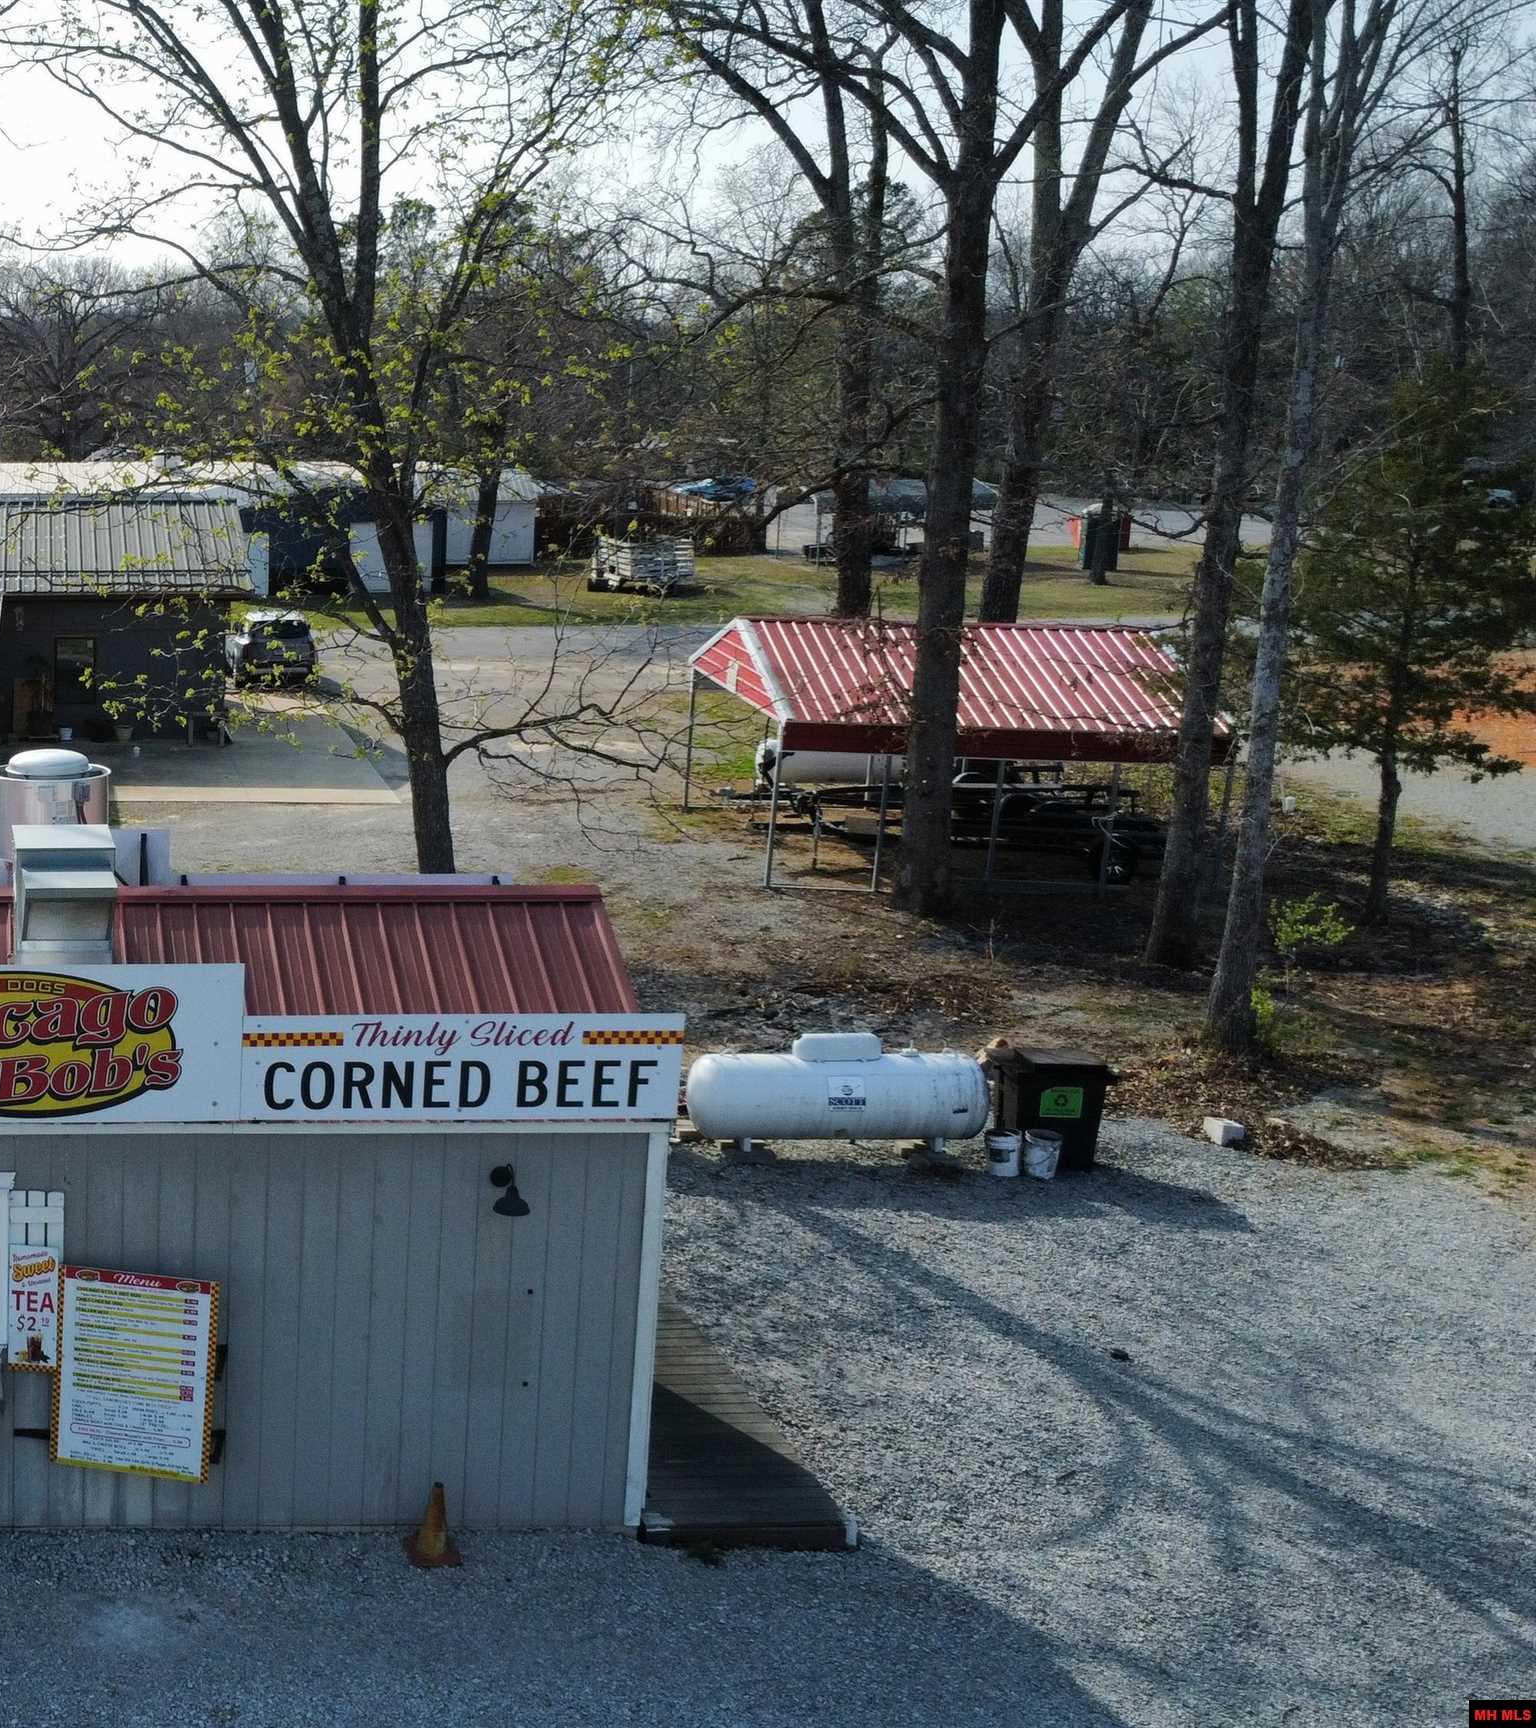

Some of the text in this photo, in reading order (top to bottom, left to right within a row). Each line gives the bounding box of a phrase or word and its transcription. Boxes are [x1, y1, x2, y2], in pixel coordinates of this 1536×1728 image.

[8, 980, 66, 995] DOGS
[351, 1020, 575, 1056] Thinly Sliced
[264, 1060, 658, 1111] CORNED BEEF
[12, 1256, 56, 1282] Sweet
[113, 1273, 162, 1288] Menu
[12, 1290, 55, 1313] TEA
